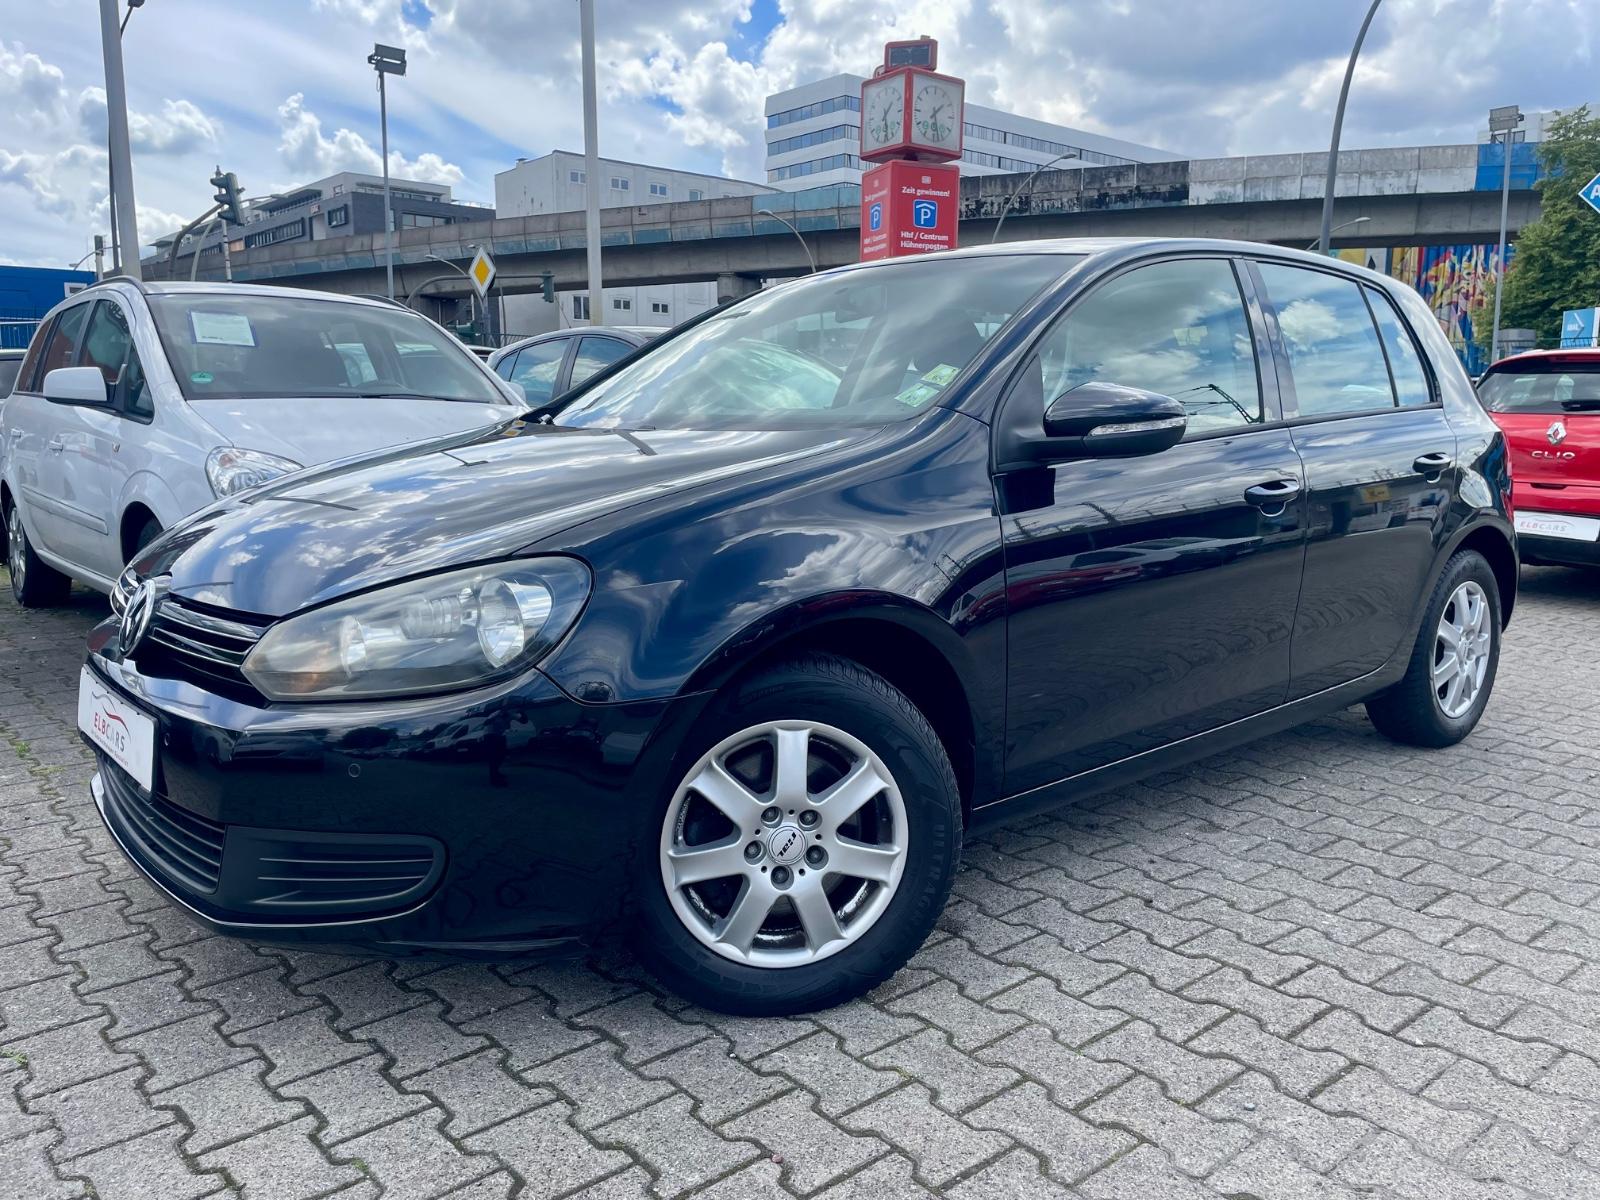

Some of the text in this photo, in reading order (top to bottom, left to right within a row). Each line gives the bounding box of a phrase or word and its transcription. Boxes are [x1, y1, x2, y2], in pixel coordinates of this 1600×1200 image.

[902, 186, 950, 197] Zeit gewinnen!
[920, 208, 931, 225] P
[900, 231, 914, 239] Hbf
[919, 232, 949, 241] Centrum
[900, 240, 949, 251] Hühnerposten
[1531, 450, 1576, 459] CLIO
[1520, 521, 1567, 532] ELBCARS
[94, 711, 125, 753] ELBCARS
